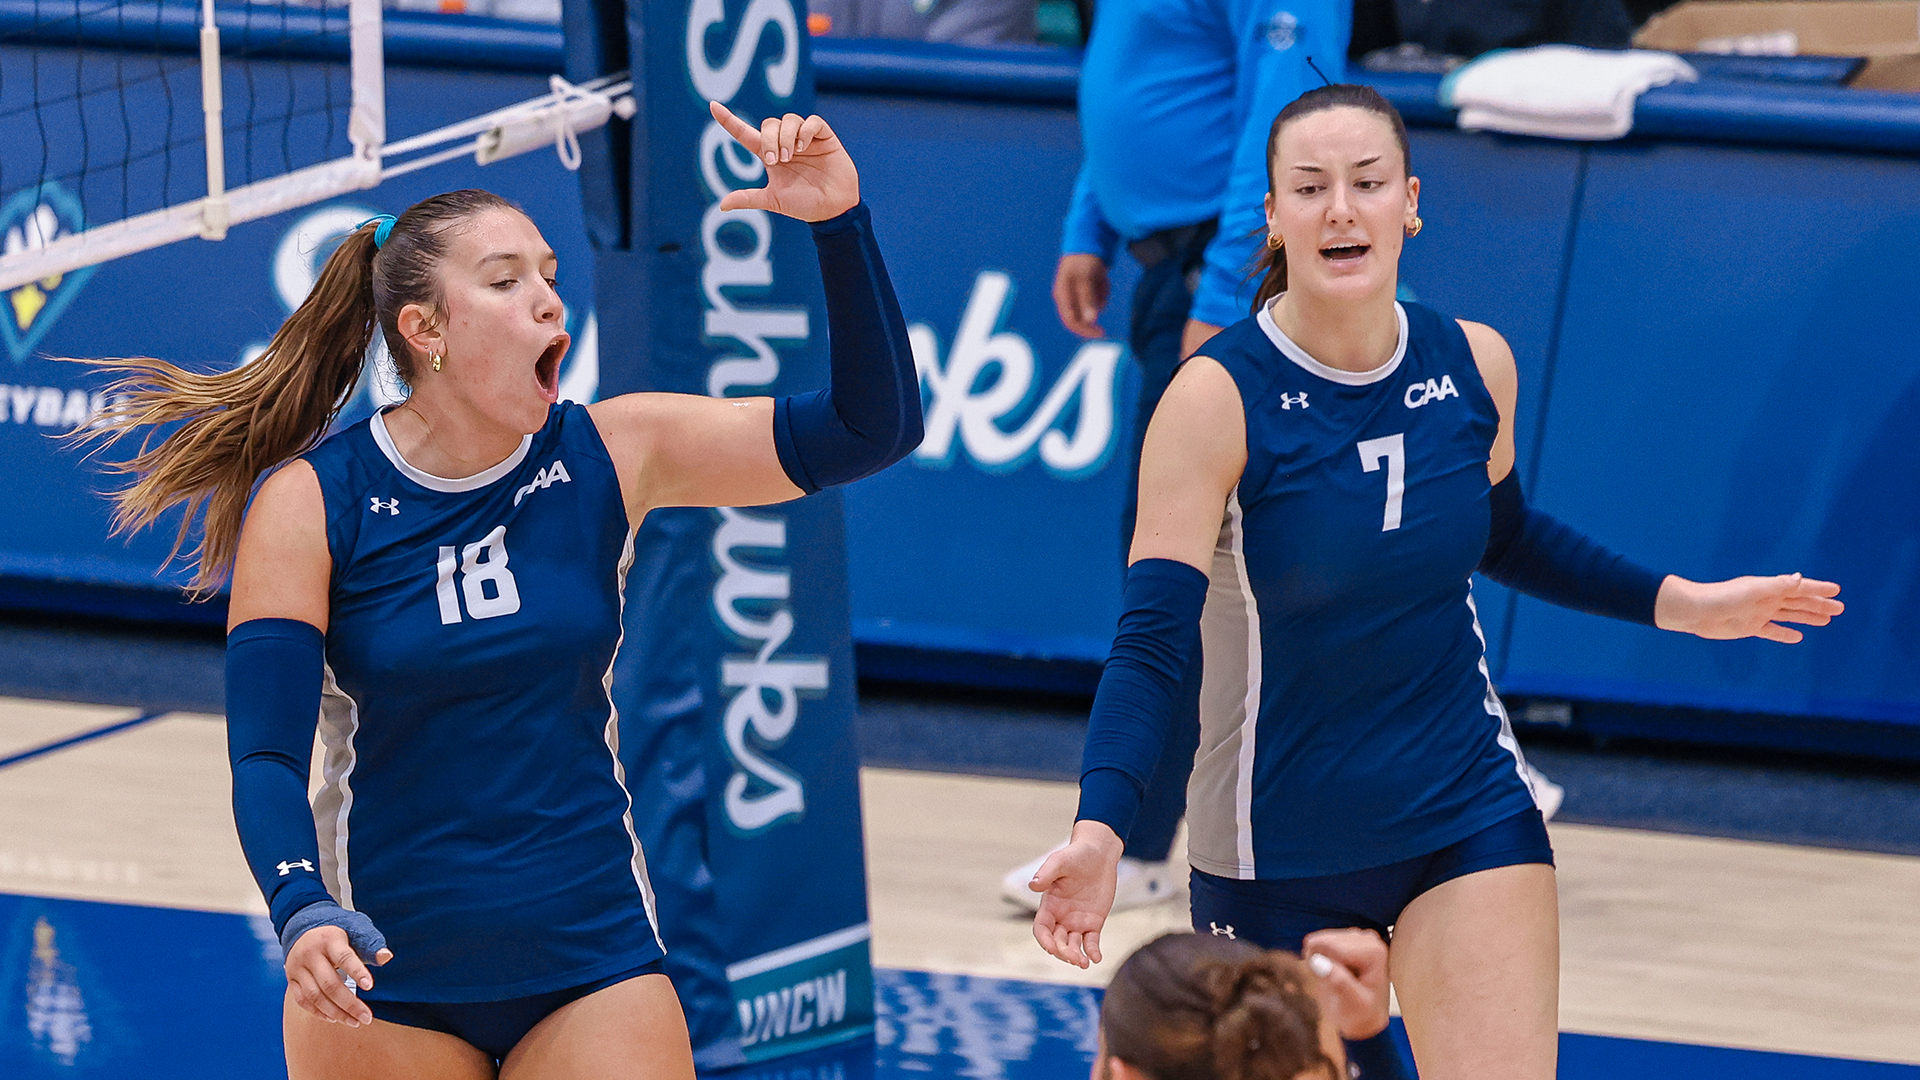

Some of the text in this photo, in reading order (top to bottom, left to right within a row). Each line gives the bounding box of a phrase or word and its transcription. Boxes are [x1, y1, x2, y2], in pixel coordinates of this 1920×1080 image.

[686, 0, 830, 830] Seahwks
[1404, 374, 1459, 409] CAA
[1356, 432, 1405, 532] 7
[436, 525, 521, 625] 18
[737, 968, 847, 1048] UNCW
